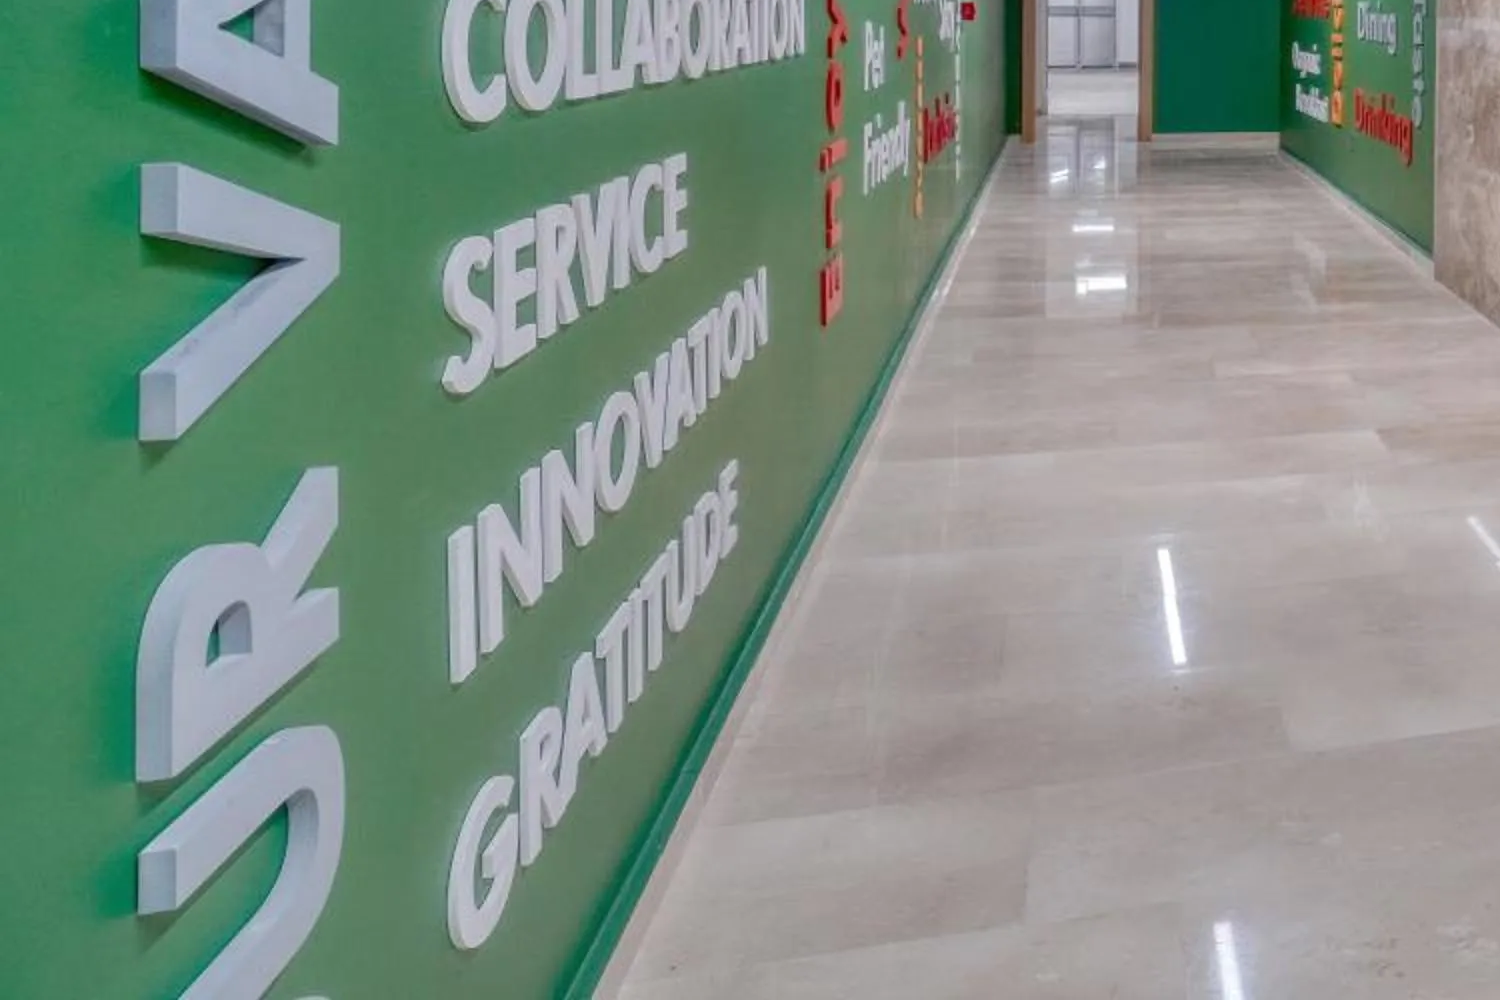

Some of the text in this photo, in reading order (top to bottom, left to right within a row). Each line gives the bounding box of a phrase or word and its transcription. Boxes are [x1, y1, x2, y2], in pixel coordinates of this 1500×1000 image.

[864, 20, 884, 92] Pet
[1356, 0, 1397, 55] Dining
[442, 152, 687, 394] SERVICE
[448, 266, 767, 684] INNOVATION
[135, 466, 346, 1000] UR
[448, 458, 739, 950] GRATITUDE
